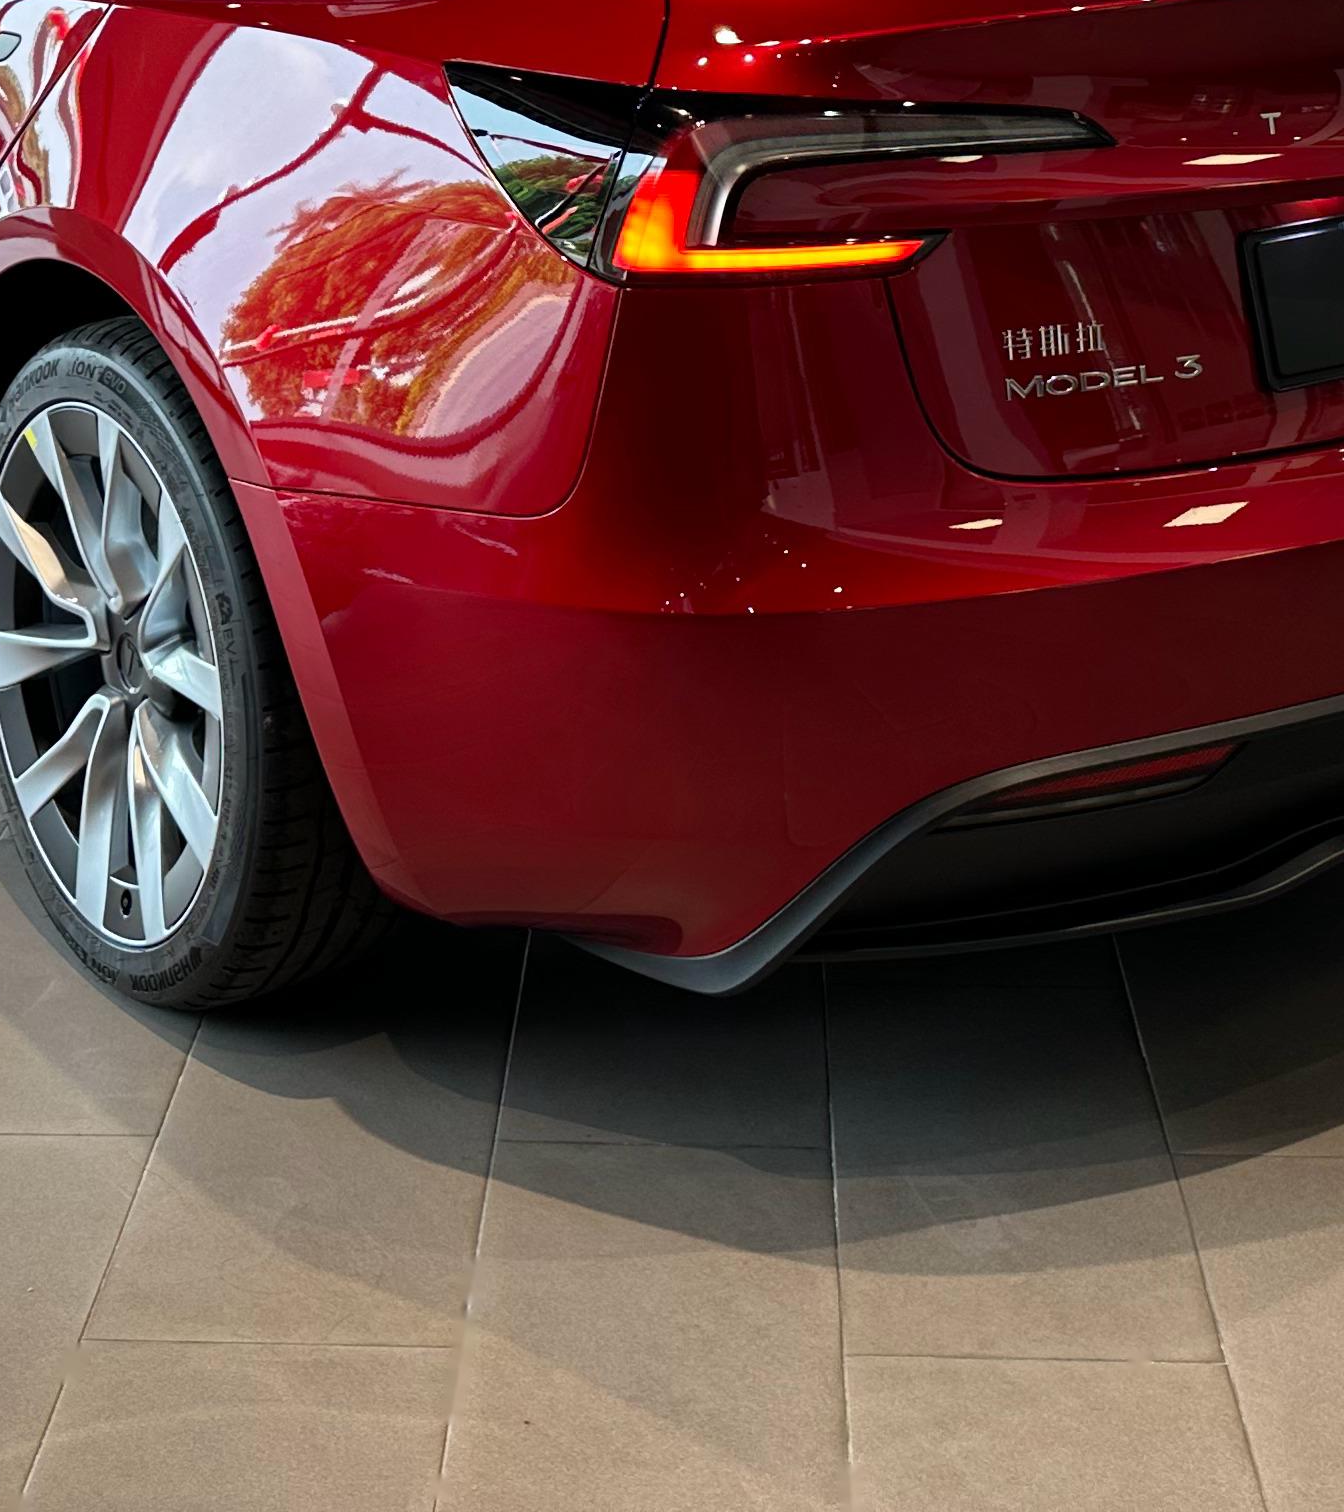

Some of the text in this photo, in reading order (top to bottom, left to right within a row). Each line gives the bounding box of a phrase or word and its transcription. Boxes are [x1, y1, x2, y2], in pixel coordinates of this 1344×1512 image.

[1002, 320, 1105, 361] 特斯拉
[1005, 354, 1204, 401] MODEL 3
